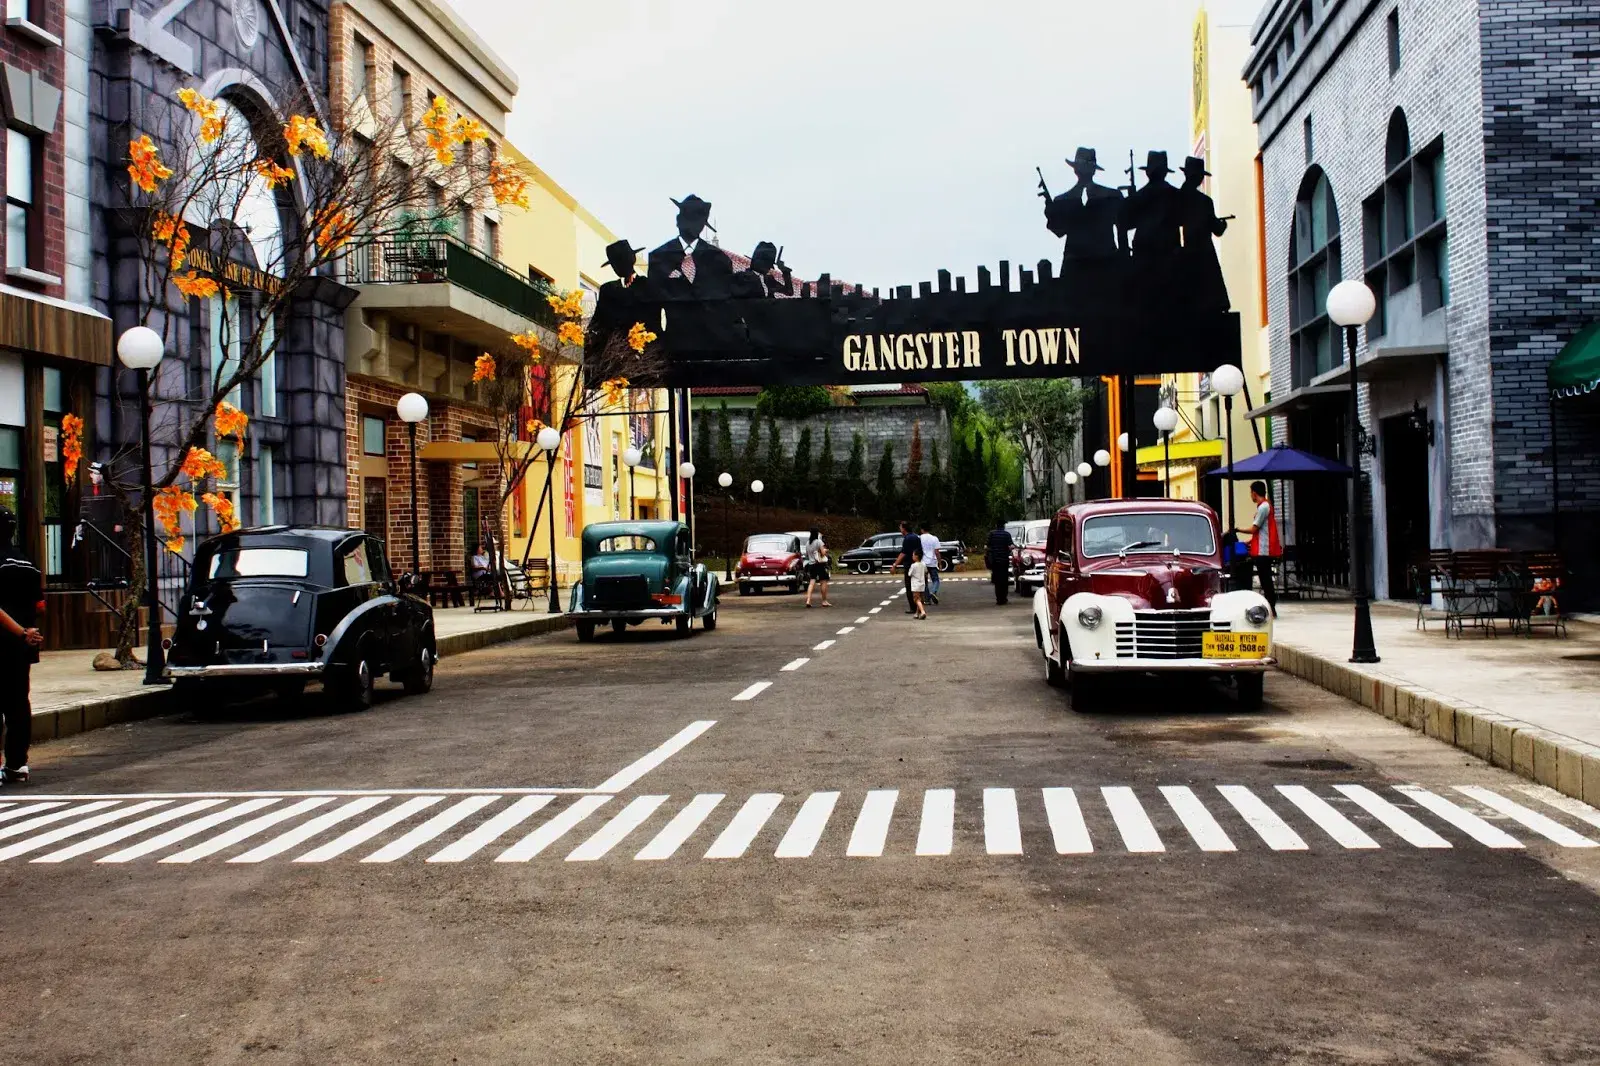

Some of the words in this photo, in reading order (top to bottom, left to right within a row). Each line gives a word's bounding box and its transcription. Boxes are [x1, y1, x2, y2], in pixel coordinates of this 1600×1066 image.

[843, 331, 982, 371] GANGSTER
[1002, 327, 1081, 366] TOWN
[1217, 643, 1234, 652] 1949
[1239, 643, 1256, 652] 1508
